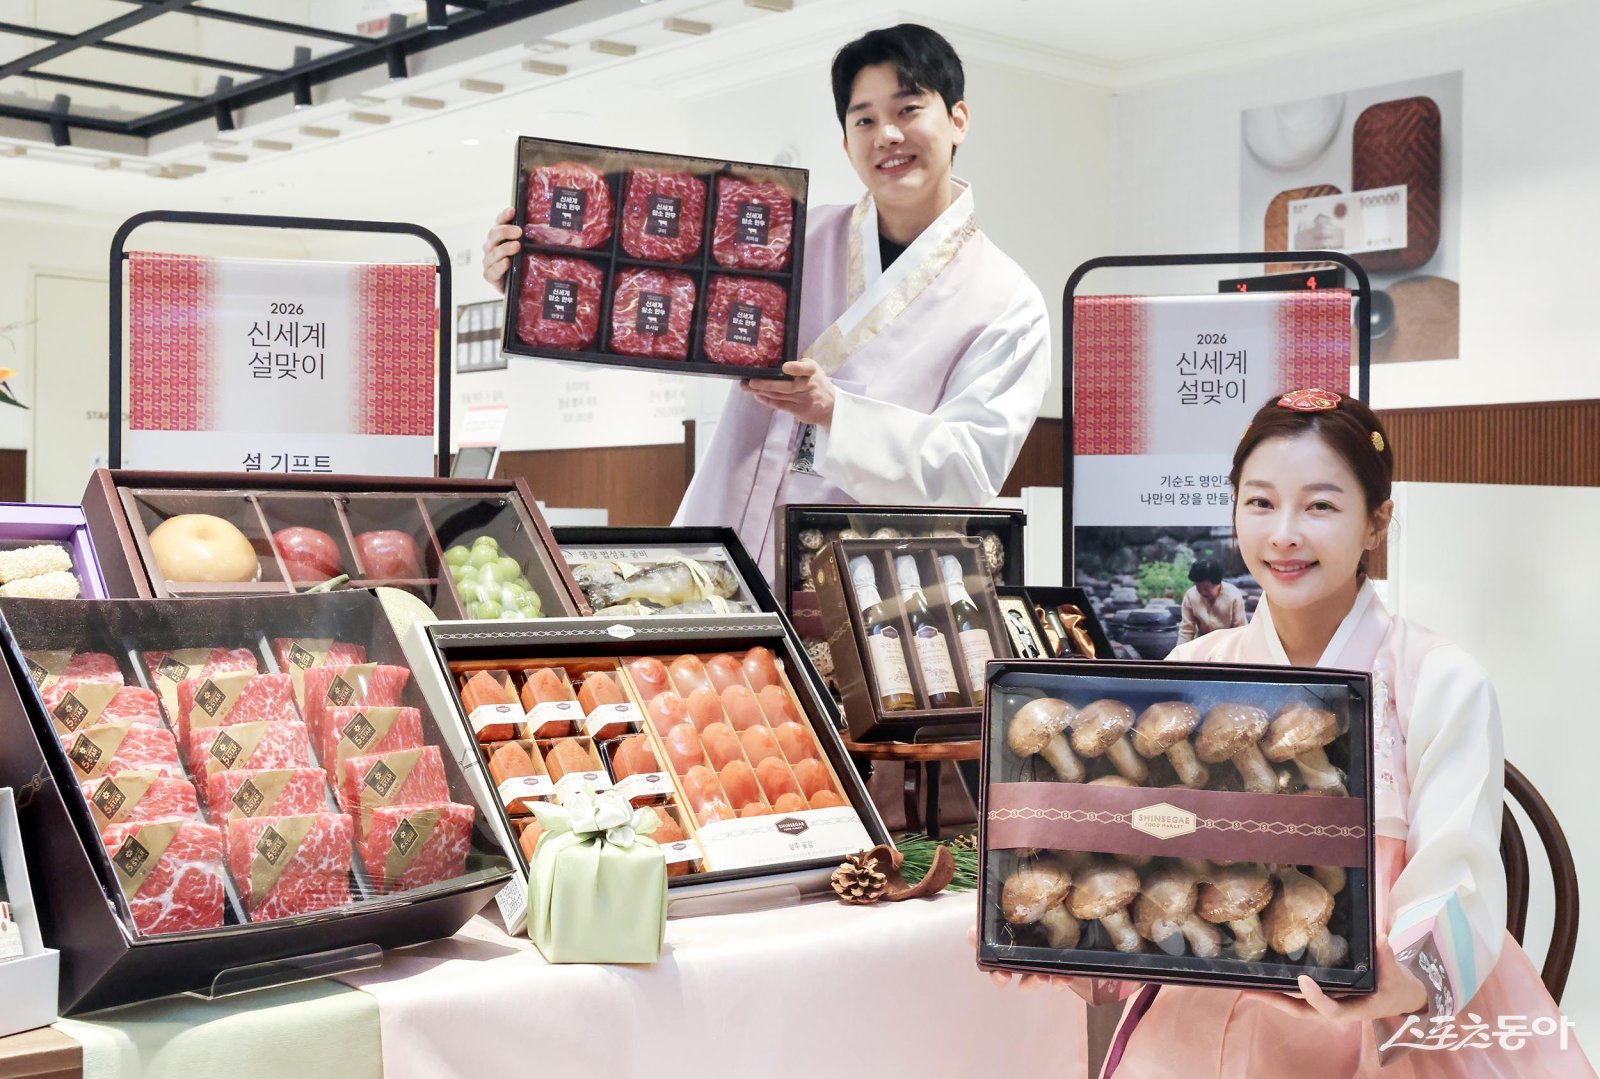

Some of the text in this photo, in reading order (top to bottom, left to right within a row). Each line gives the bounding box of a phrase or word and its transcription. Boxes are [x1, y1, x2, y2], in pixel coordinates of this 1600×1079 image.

[271, 303, 304, 315] 2026
[247, 320, 325, 349] 신세계
[1197, 333, 1228, 345] 2026
[248, 352, 324, 380] 설맞이
[1176, 350, 1247, 375] 신세계
[1177, 379, 1246, 405] 설맞이
[242, 453, 333, 473] 설 기프트
[1160, 475, 1195, 488] 기순도
[1140, 493, 1175, 505] 나만의
[1179, 493, 1202, 506] 장을
[1138, 813, 1191, 825] SHINSEGAE
